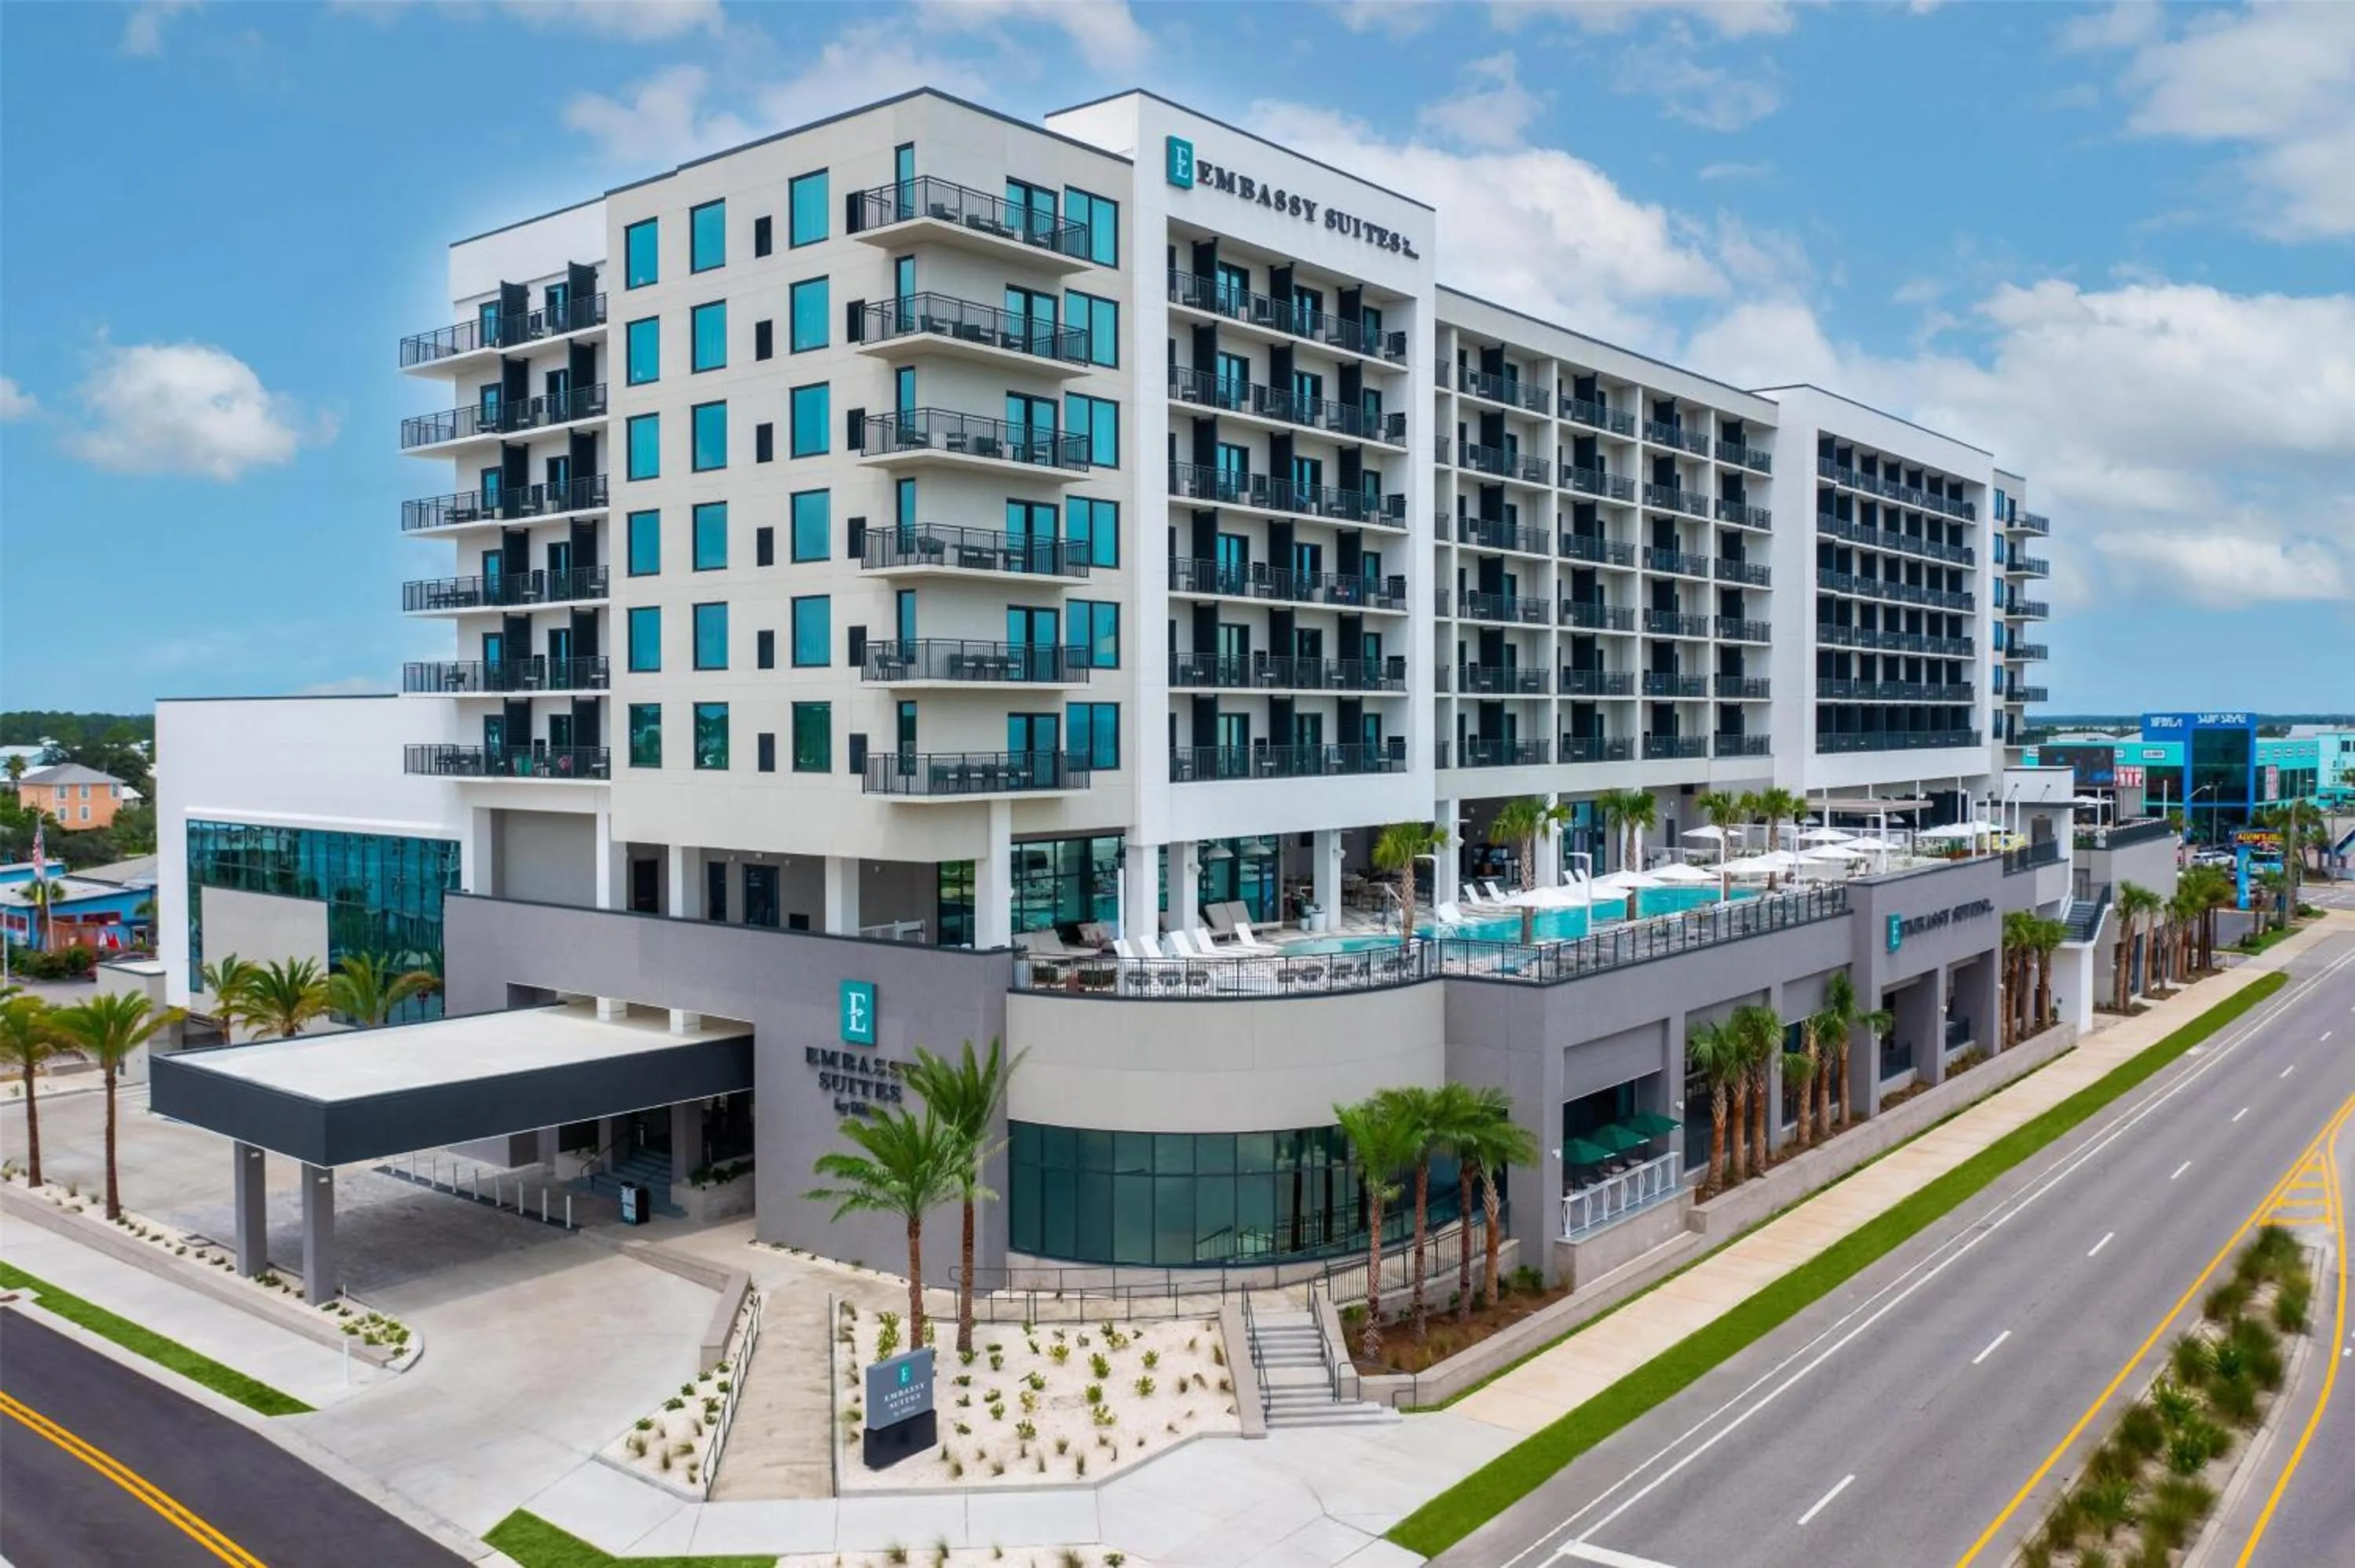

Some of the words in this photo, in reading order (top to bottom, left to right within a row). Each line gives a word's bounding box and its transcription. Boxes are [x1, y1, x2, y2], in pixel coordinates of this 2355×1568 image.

[1177, 146, 1189, 179] E
[1196, 159, 1319, 223] EMBASSY
[1324, 207, 1401, 254] SUITES
[848, 991, 867, 1034] E
[805, 1046, 920, 1078] EMBASS
[819, 1070, 902, 1103] SUITES
[884, 1381, 926, 1402] EMBASSY
